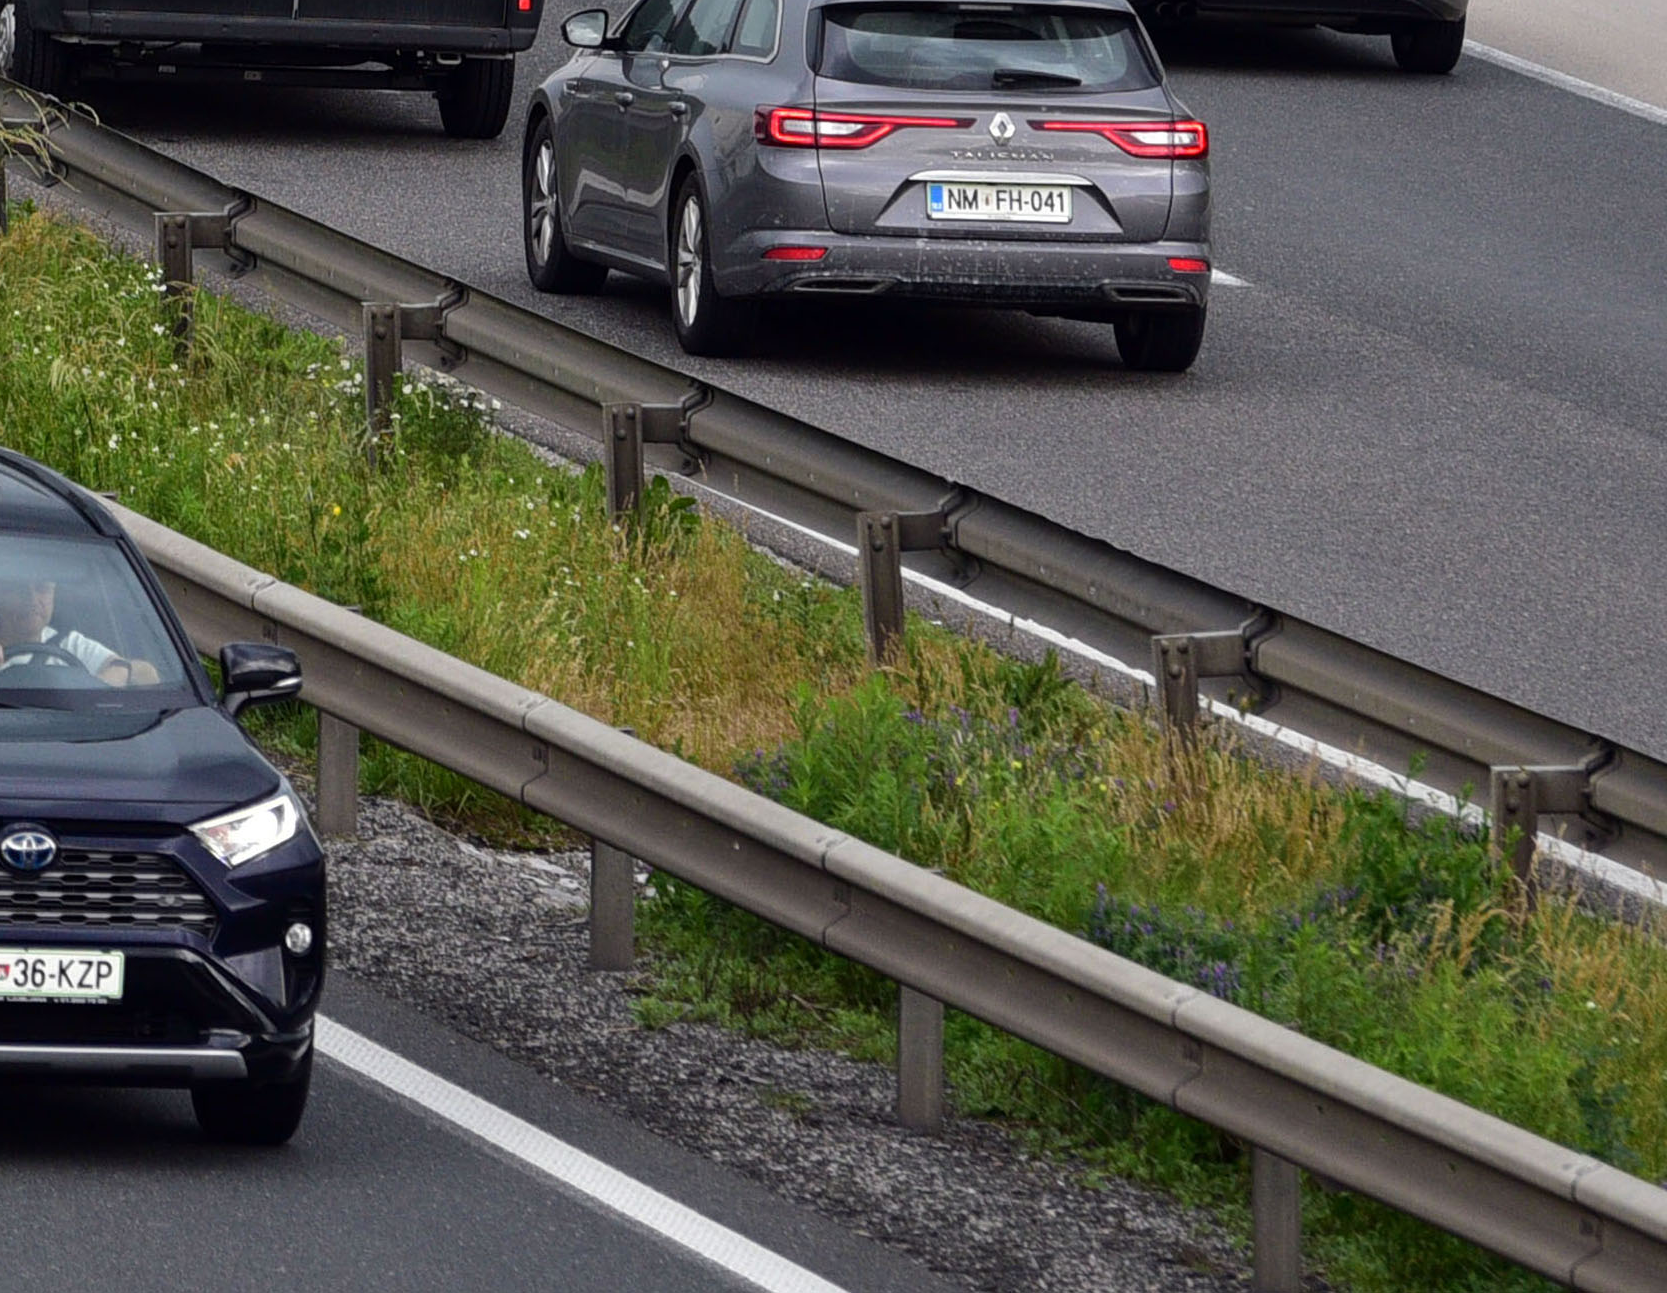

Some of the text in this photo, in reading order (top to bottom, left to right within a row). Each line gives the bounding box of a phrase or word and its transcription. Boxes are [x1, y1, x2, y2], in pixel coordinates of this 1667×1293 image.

[948, 188, 1065, 212] NM FH-041
[13, 958, 113, 990] 36-KZP
